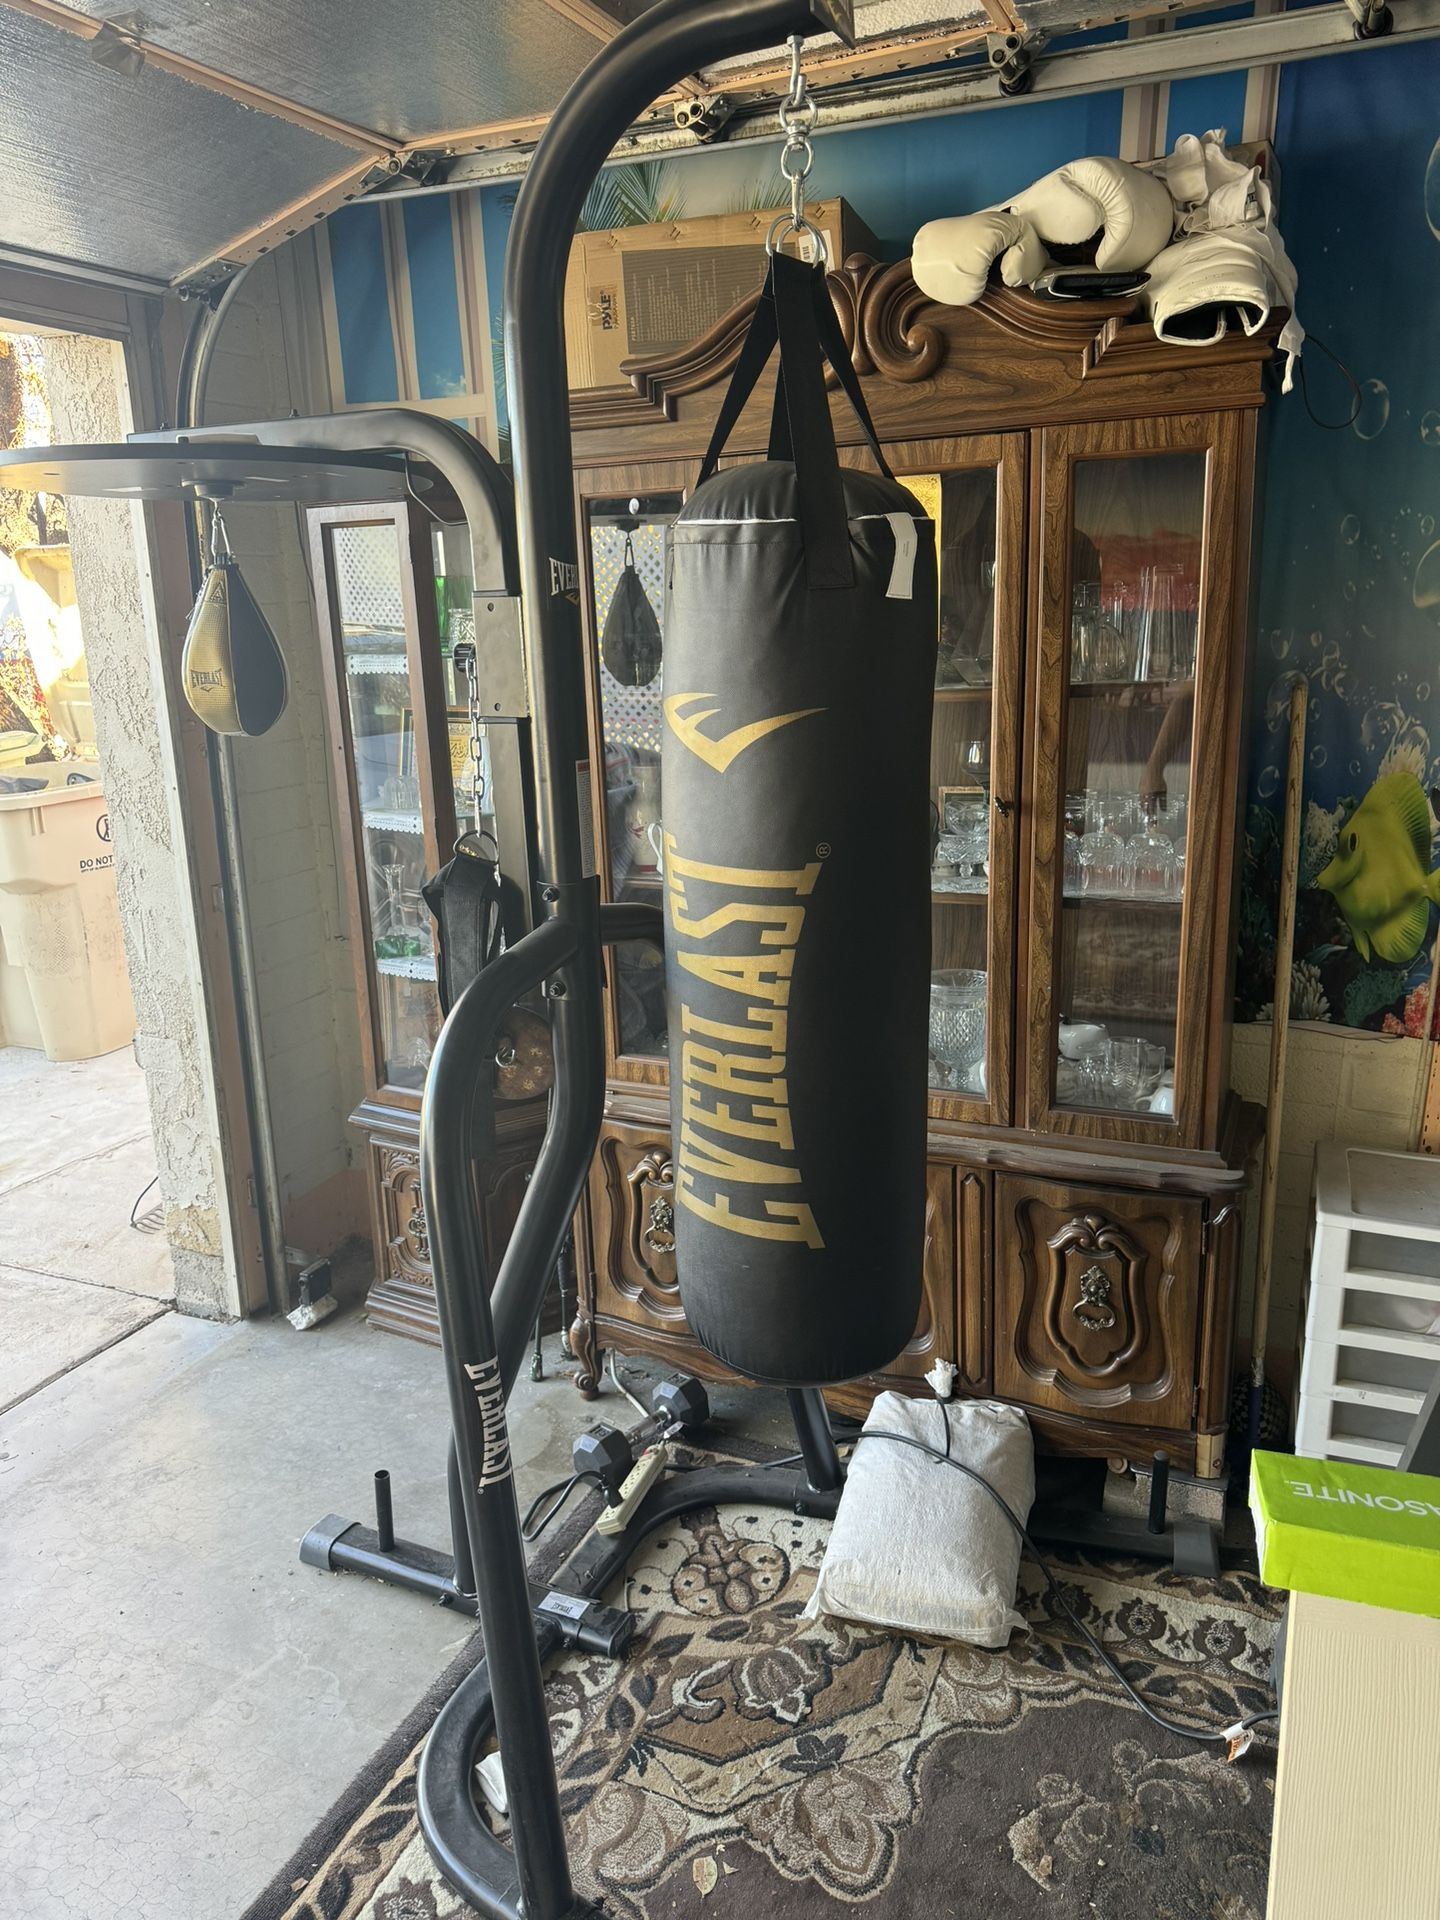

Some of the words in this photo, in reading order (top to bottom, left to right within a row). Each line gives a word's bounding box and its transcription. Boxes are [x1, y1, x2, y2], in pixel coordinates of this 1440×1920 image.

[80, 859, 94, 869] DO
[96, 855, 113, 865] NOT
[664, 831, 826, 1249] EVERLAST
[464, 1355, 513, 1488] EVERLAST
